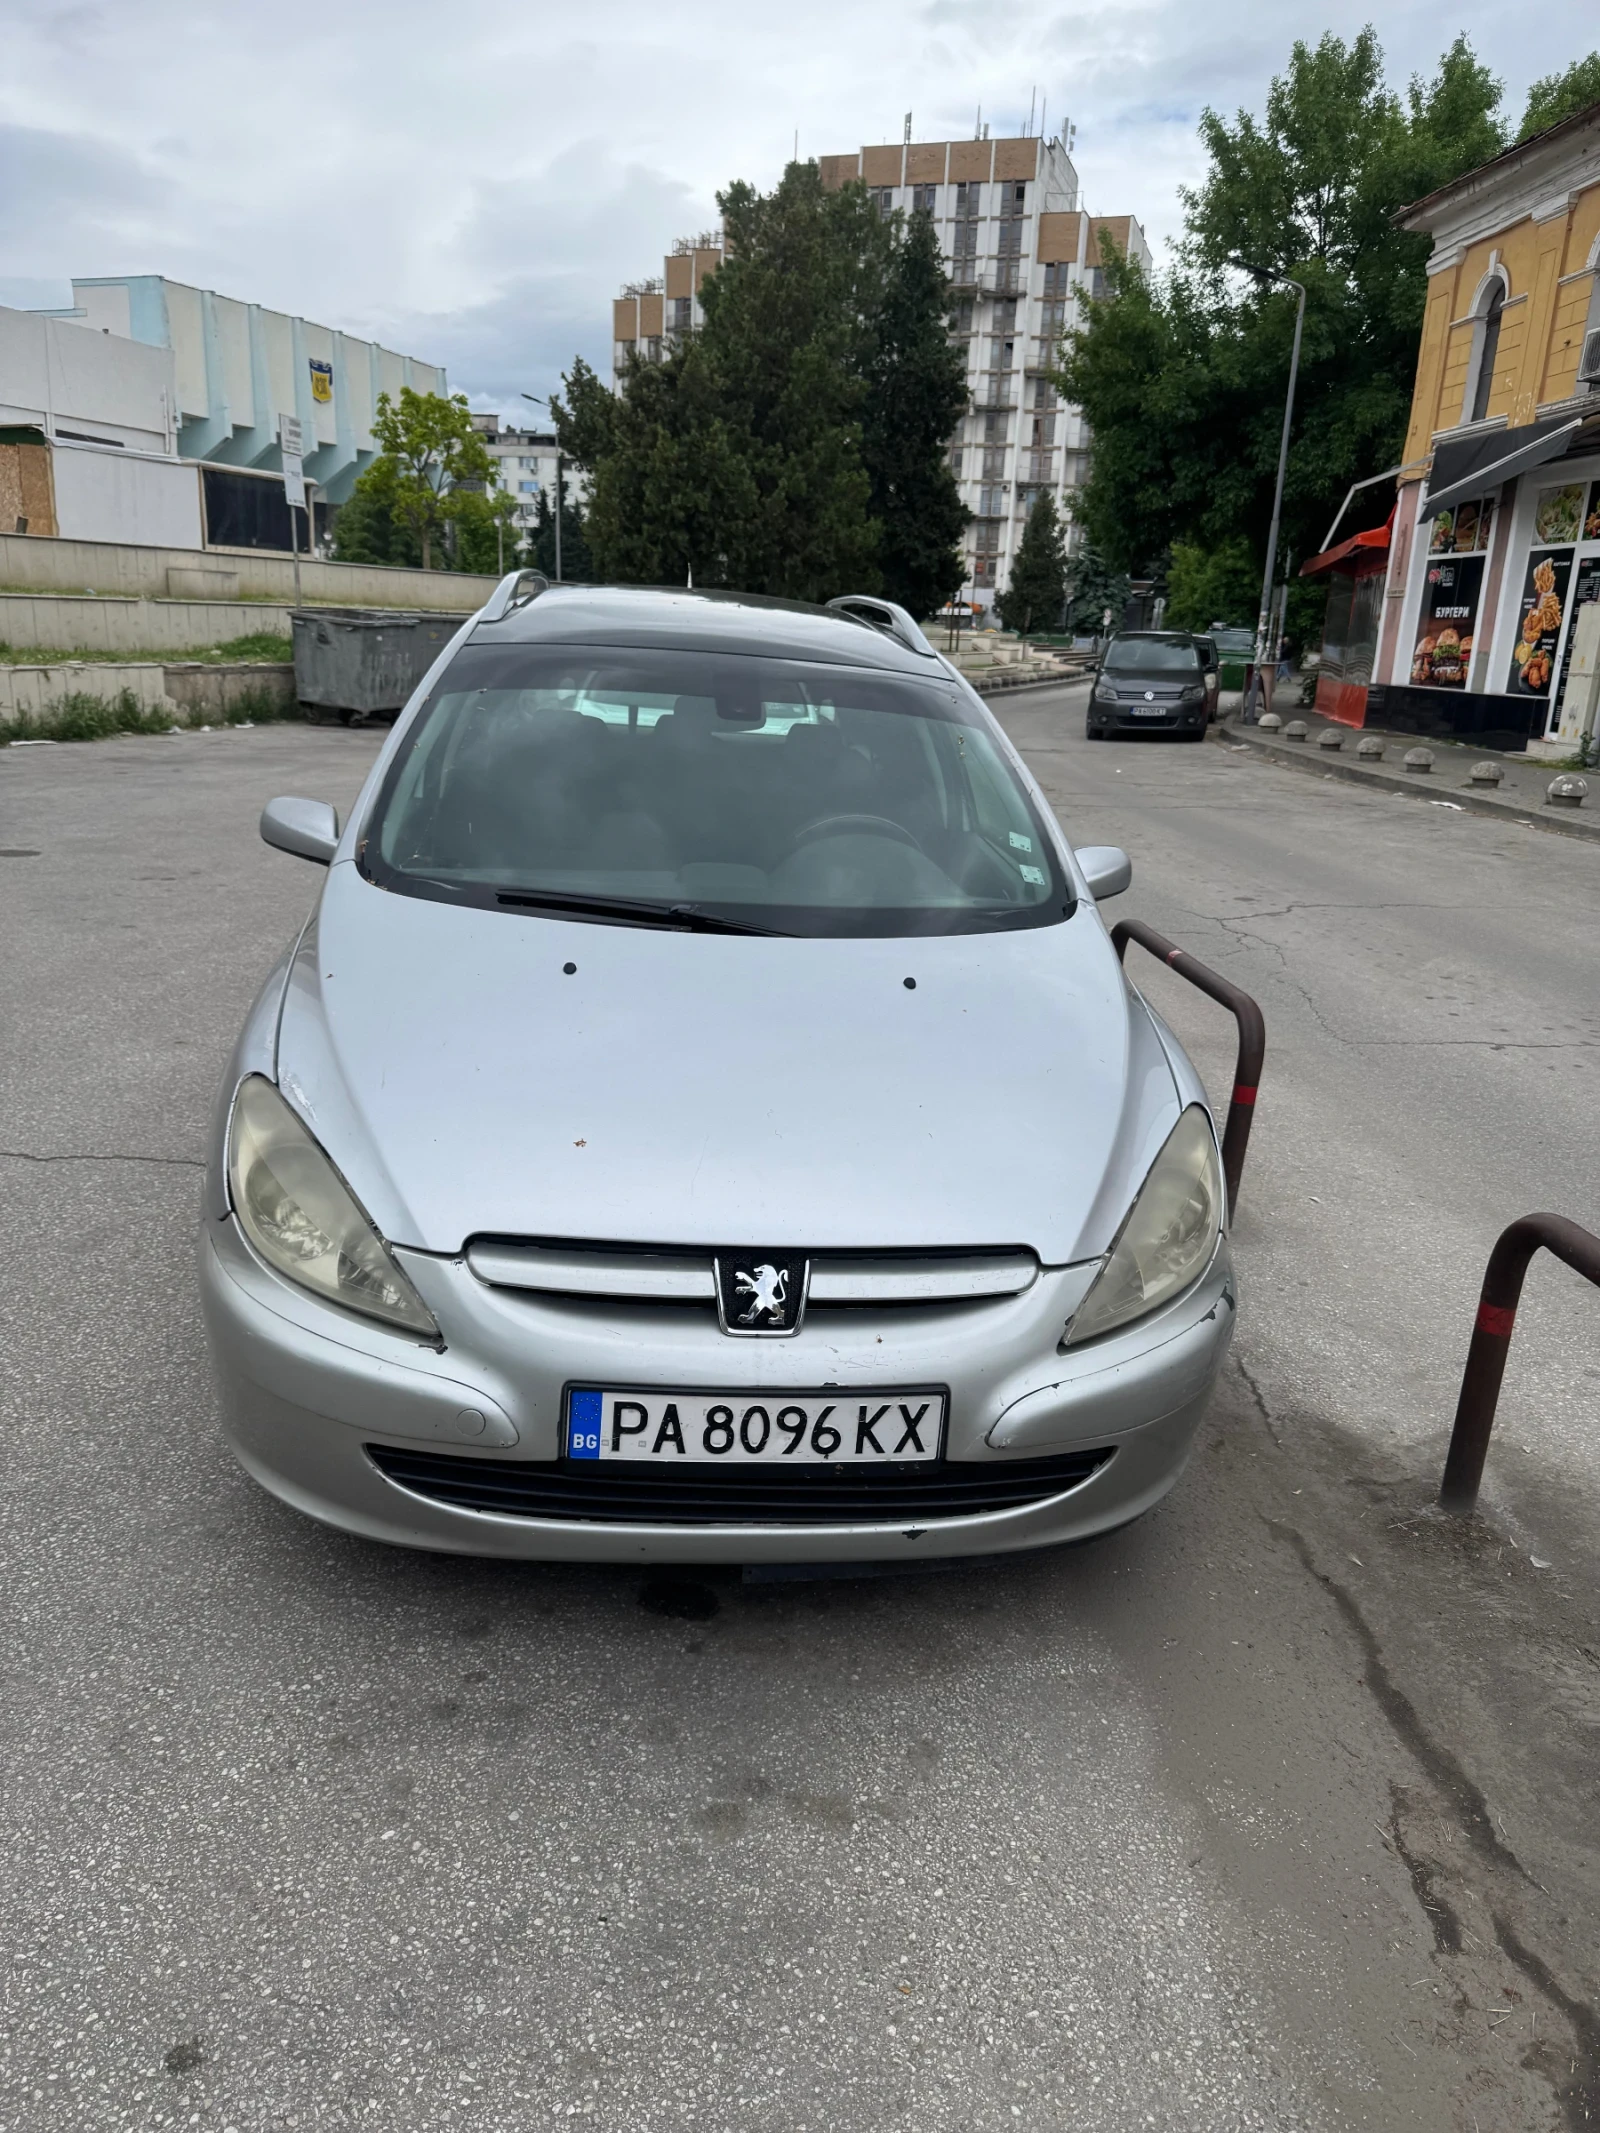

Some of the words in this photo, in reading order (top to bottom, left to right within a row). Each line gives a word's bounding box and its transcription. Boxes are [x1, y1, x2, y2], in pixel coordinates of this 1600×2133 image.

[1435, 606, 1470, 618] БУРГЕРИ
[611, 1401, 686, 1454] PA
[703, 1404, 842, 1455] 8096
[854, 1403, 931, 1454] KX
[573, 1433, 597, 1449] BG
